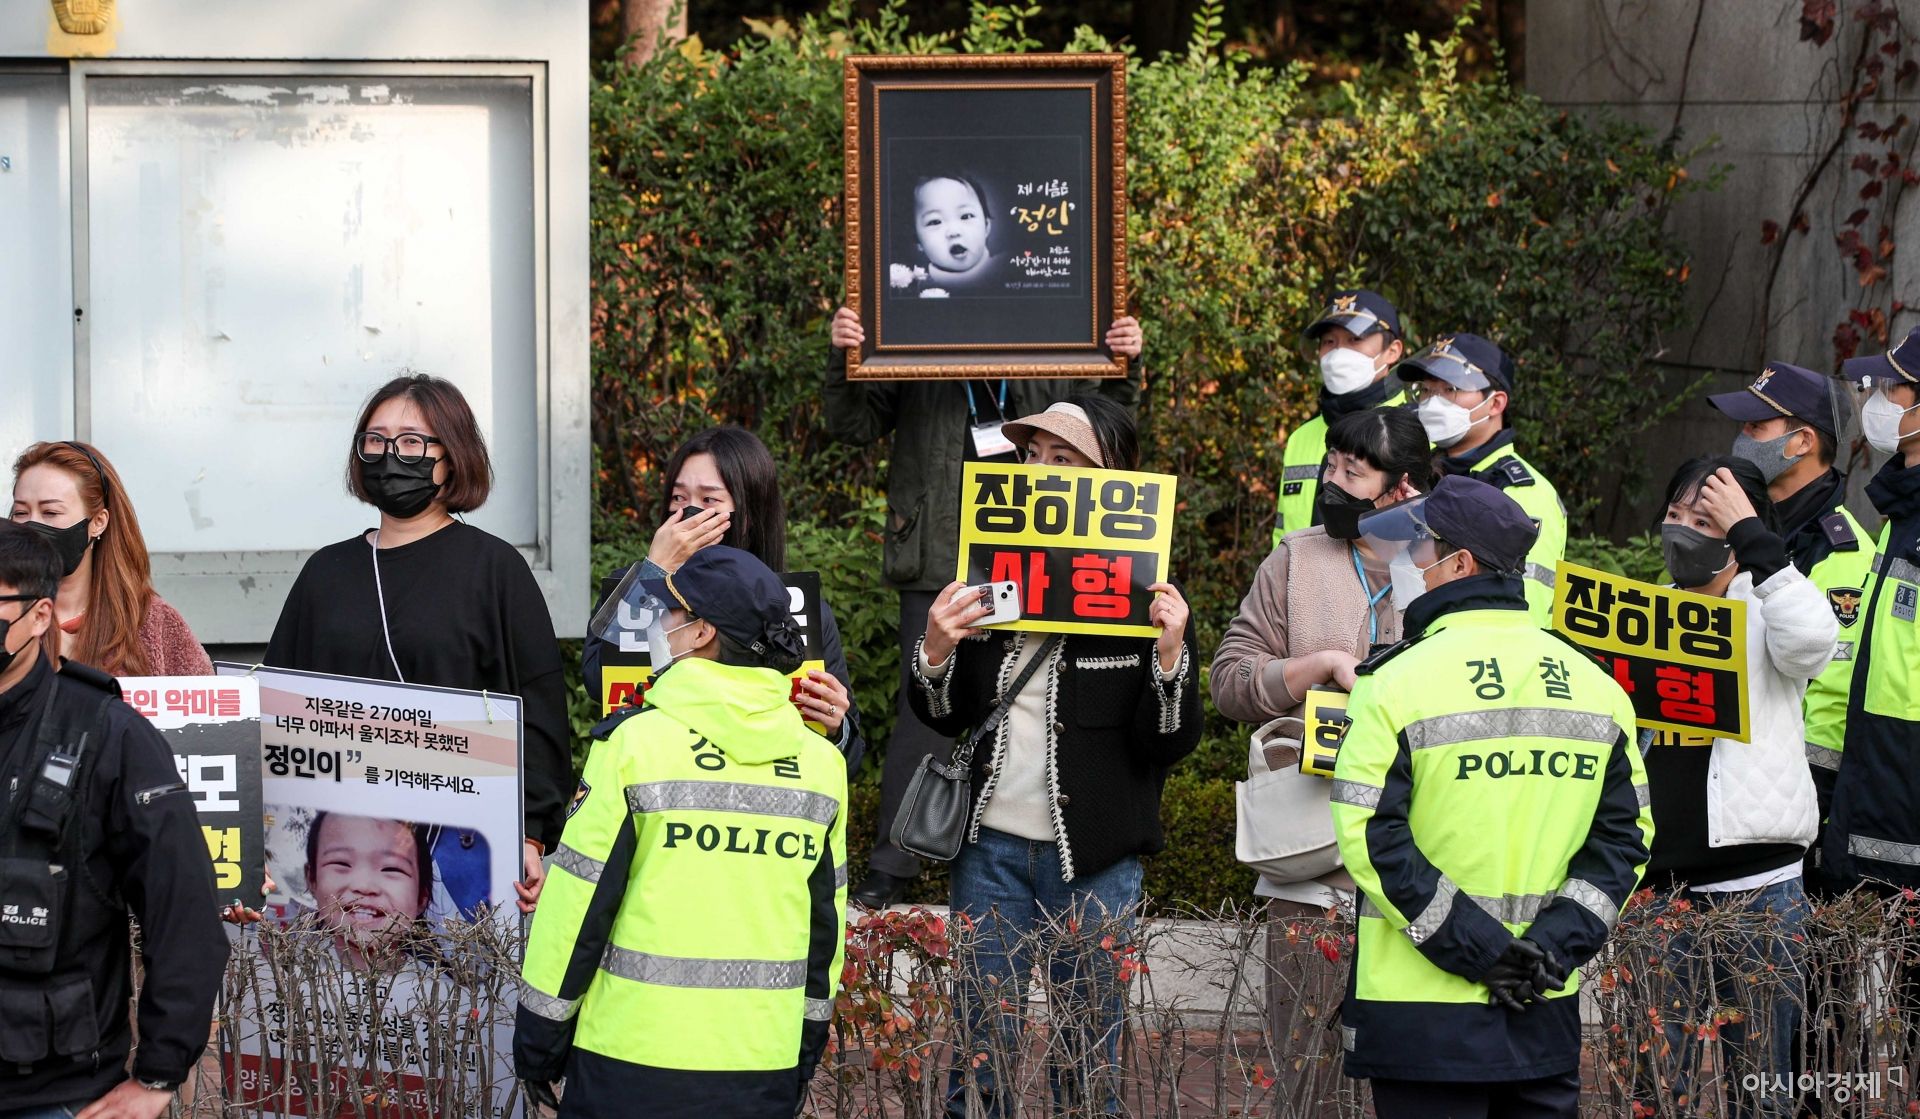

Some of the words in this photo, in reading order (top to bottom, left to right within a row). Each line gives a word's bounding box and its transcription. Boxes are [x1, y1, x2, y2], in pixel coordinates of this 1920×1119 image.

[1017, 182, 1033, 196] 제
[974, 473, 1161, 541] 장하영
[1071, 553, 1133, 619] 형
[1564, 572, 1733, 660] 장하영
[164, 689, 241, 717] 악마들
[305, 697, 365, 720] 지옥같은
[369, 705, 438, 729] 270여일,
[276, 715, 306, 733] 너무
[309, 718, 354, 740] 아파서
[358, 725, 419, 748] 울지조차
[422, 732, 469, 754] 못했던
[364, 766, 381, 784] 를
[384, 769, 481, 795] 기억해주세요.
[1455, 750, 1599, 780] POLICE
[663, 822, 818, 861] POLICE
[2, 914, 48, 926] POLICE
